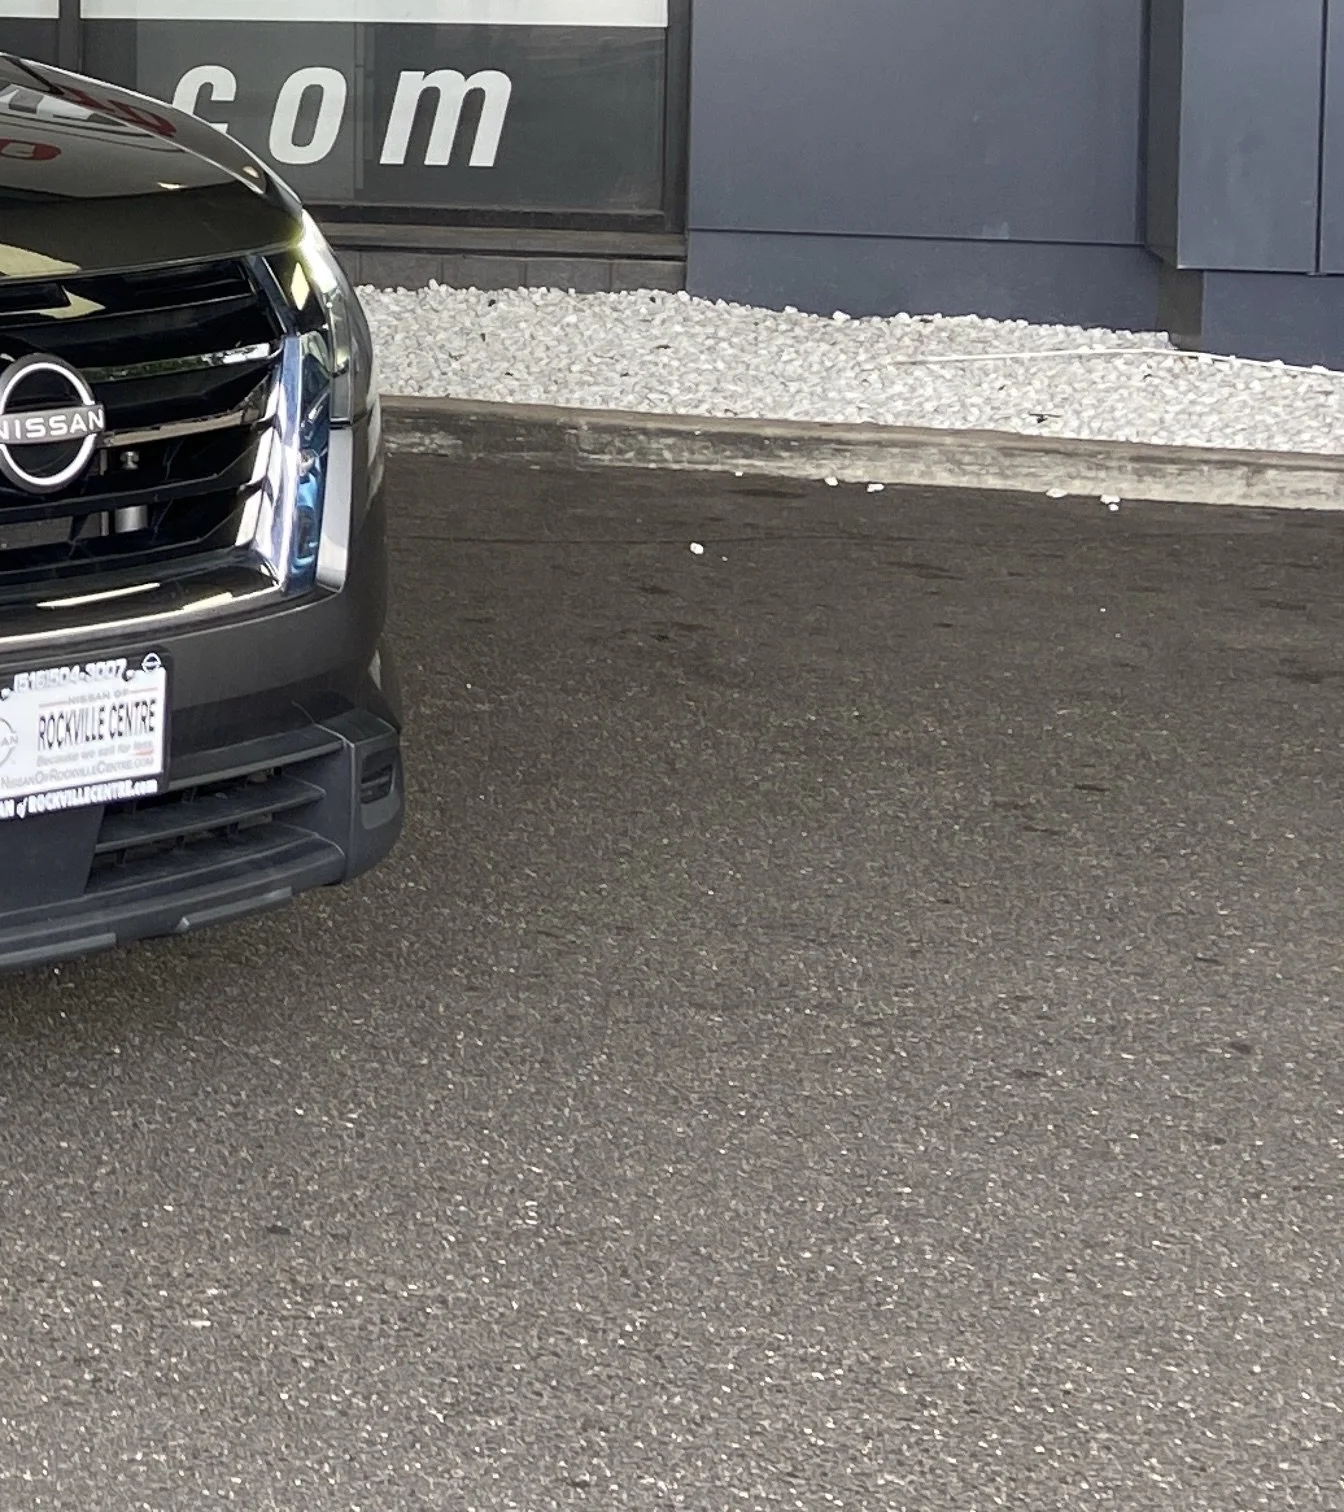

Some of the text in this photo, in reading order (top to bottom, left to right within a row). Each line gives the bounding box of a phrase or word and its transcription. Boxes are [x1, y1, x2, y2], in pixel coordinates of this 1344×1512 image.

[68, 690, 111, 705] NISSAN
[37, 697, 157, 751] ROCKVILLE CENTRE
